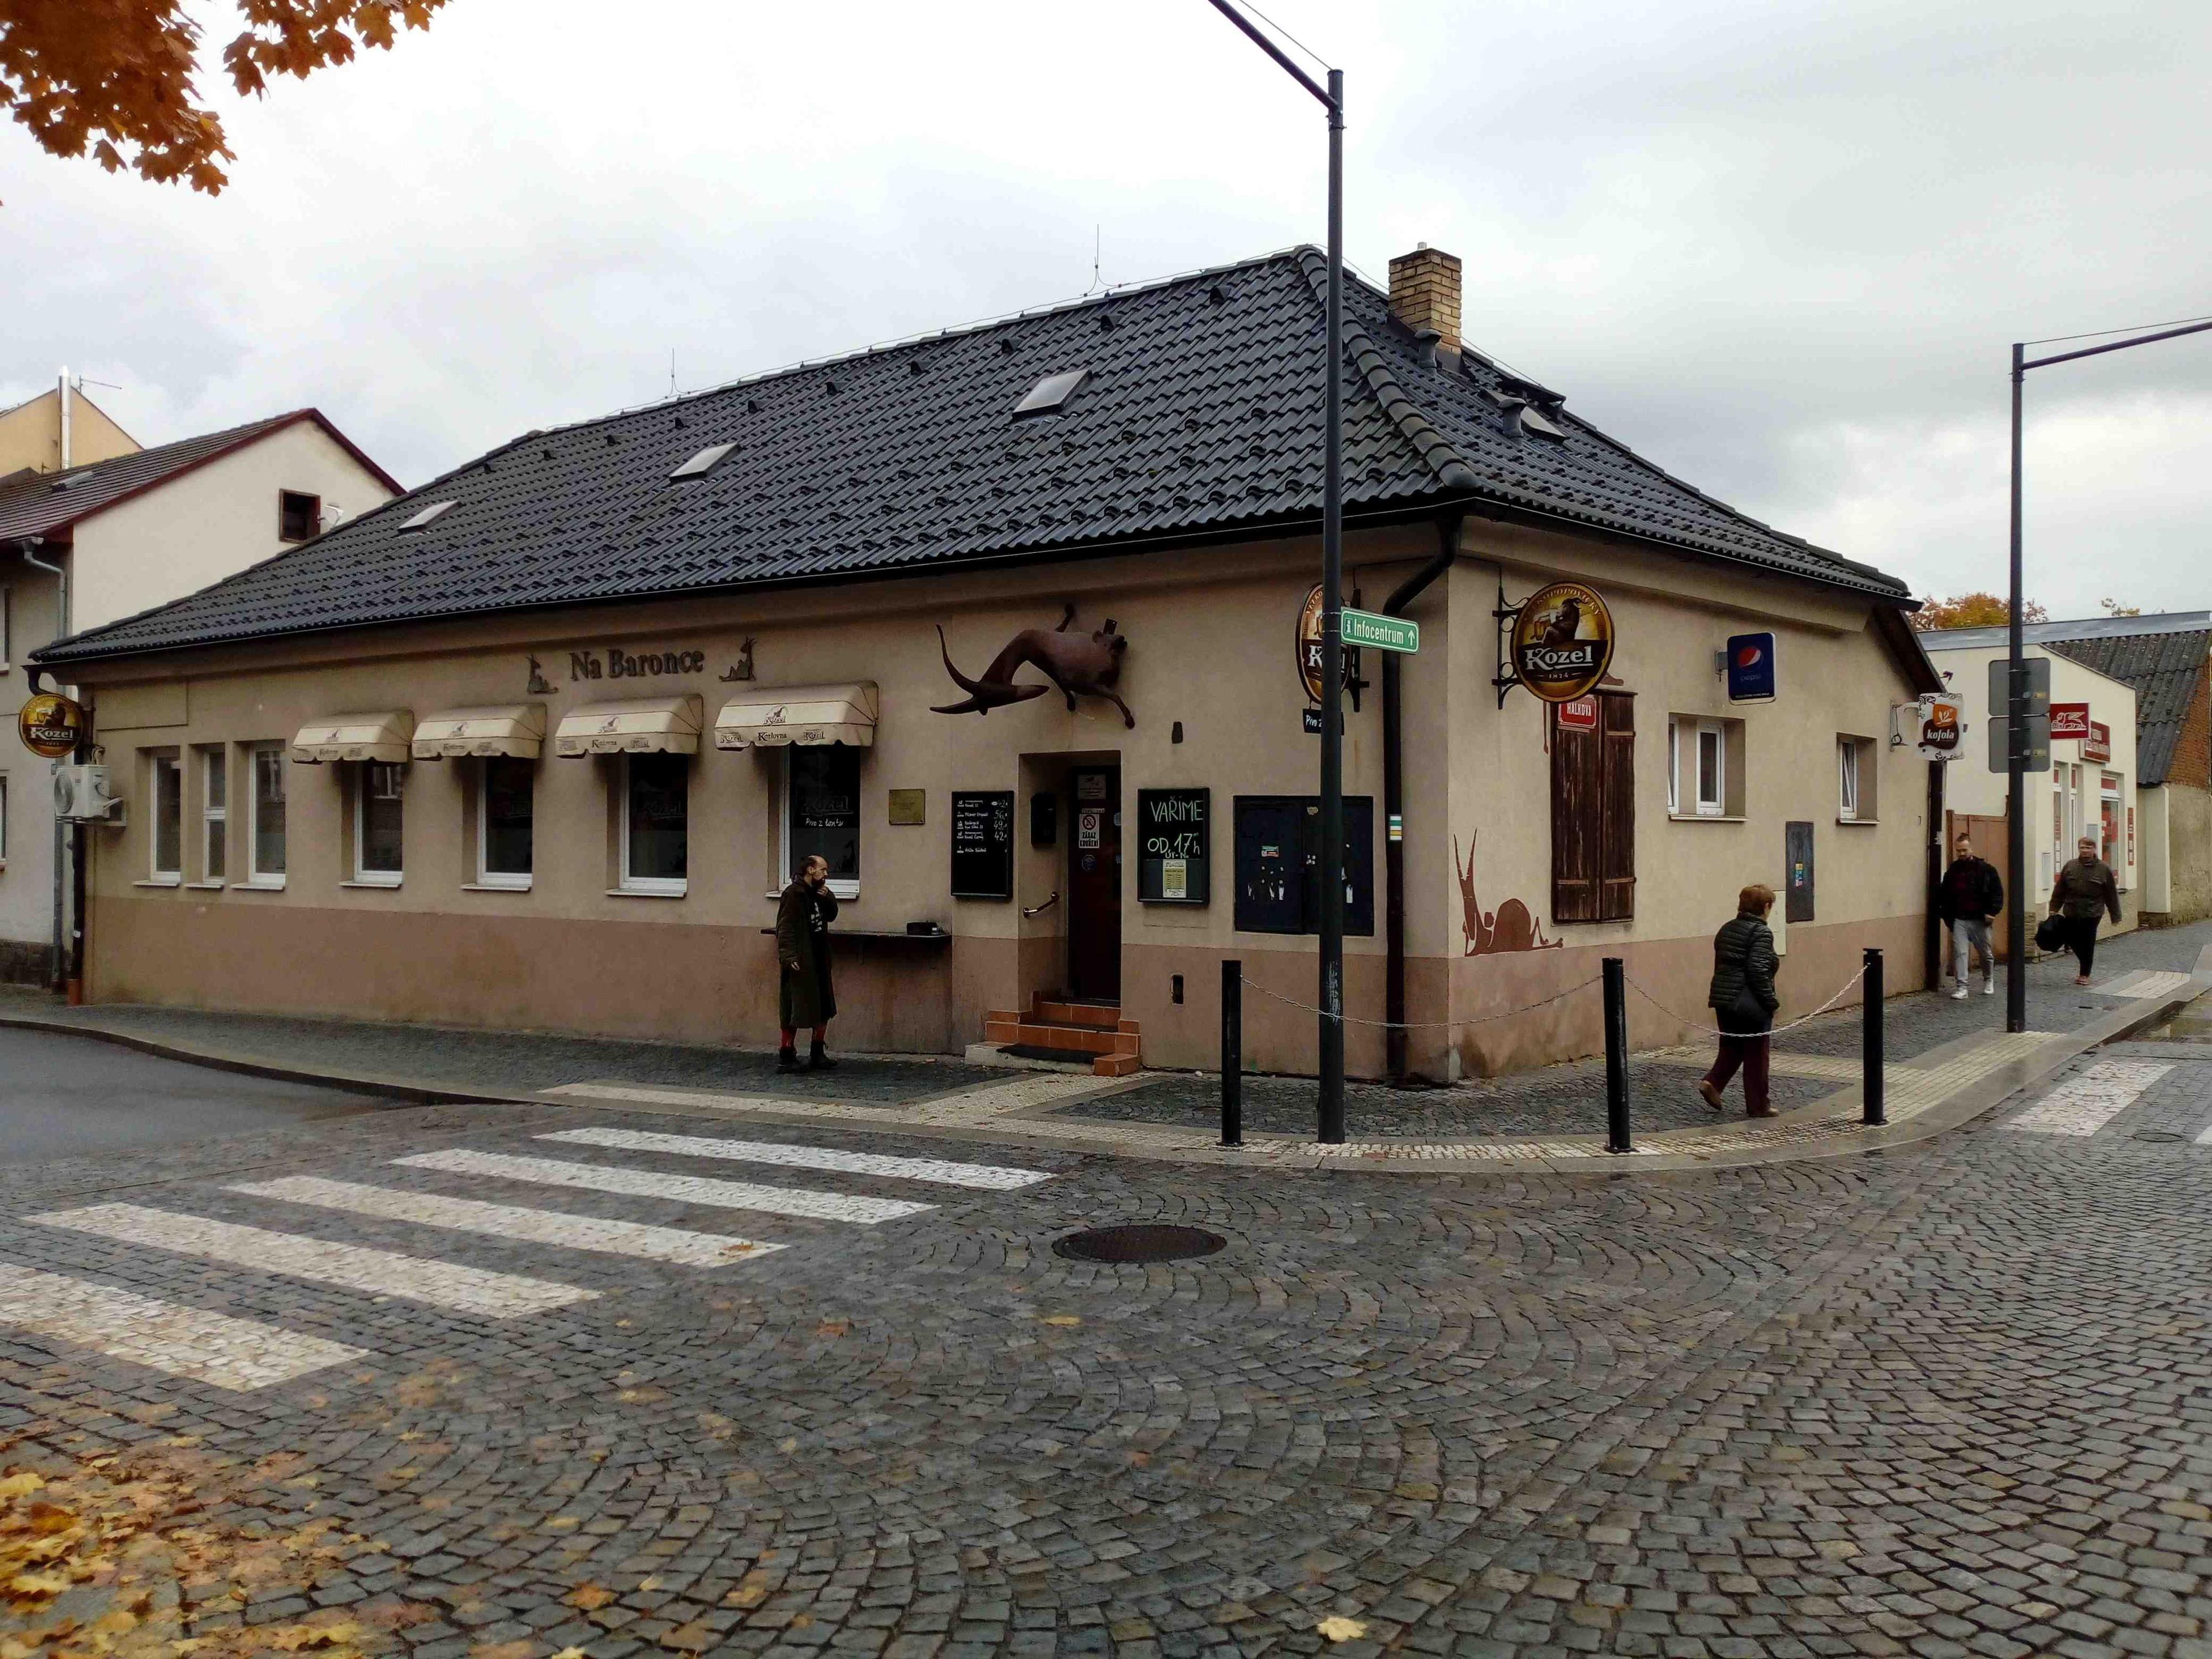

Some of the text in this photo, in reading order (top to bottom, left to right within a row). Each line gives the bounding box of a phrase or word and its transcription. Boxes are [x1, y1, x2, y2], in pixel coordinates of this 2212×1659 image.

[1355, 618, 1404, 644] Infocentrum
[568, 648, 705, 681] Na Baronce
[1525, 645, 1594, 670] Kozel
[30, 727, 74, 741] Kozel
[1926, 729, 1955, 742] kofola
[1150, 795, 1204, 822] VAŘÍME
[1082, 831, 1097, 839] ZÁKAZ
[1147, 837, 1168, 854] OD
